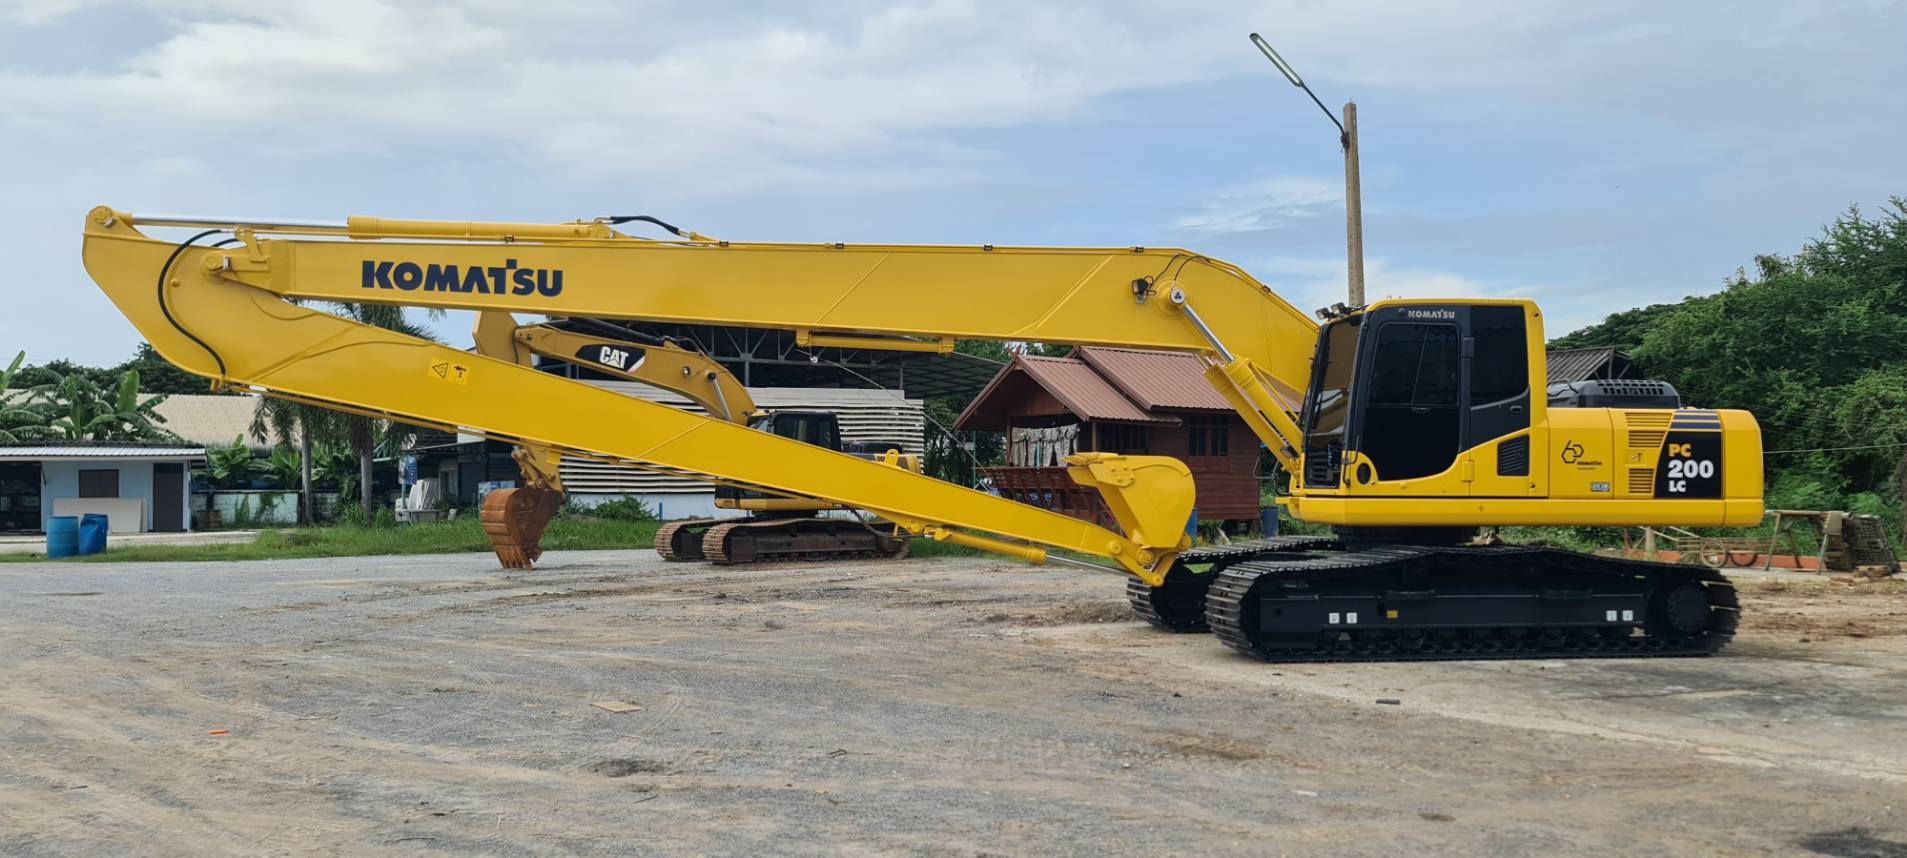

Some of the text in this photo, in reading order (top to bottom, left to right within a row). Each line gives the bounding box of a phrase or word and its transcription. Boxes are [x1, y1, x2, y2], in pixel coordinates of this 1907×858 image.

[362, 259, 563, 297] KOMATSU
[1408, 309, 1455, 319] KOMATSU
[600, 346, 629, 369] CAT
[1668, 443, 1692, 457] PC
[1667, 459, 1715, 478] 200
[1668, 480, 1687, 492] LC
